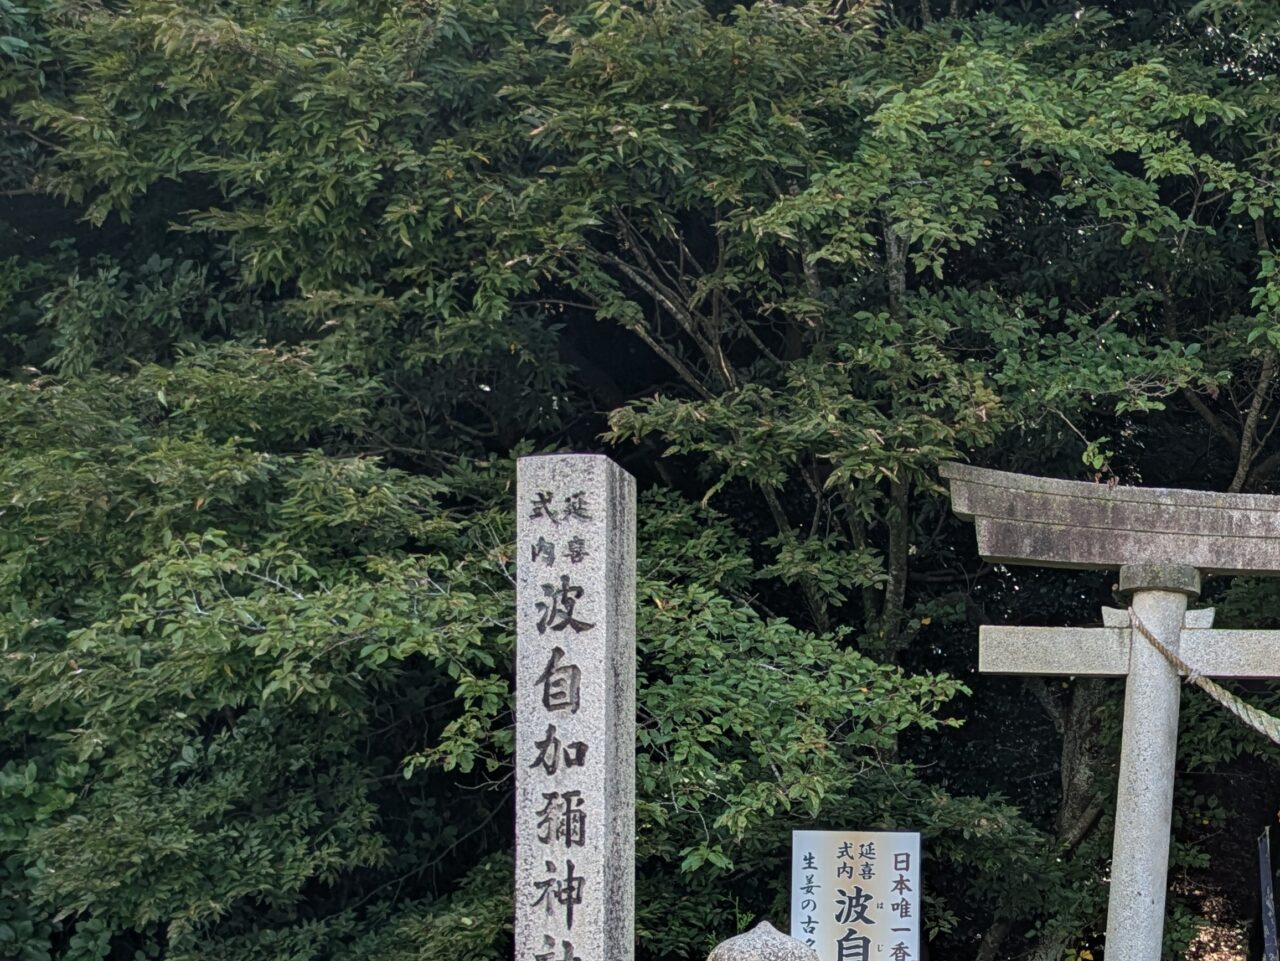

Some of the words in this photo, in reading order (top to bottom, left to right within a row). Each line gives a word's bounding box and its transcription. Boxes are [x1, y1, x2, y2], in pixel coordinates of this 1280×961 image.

[528, 490, 559, 566] 式内
[561, 490, 593, 563] 延喜
[836, 841, 854, 880] 式内
[857, 841, 876, 881] 延喜
